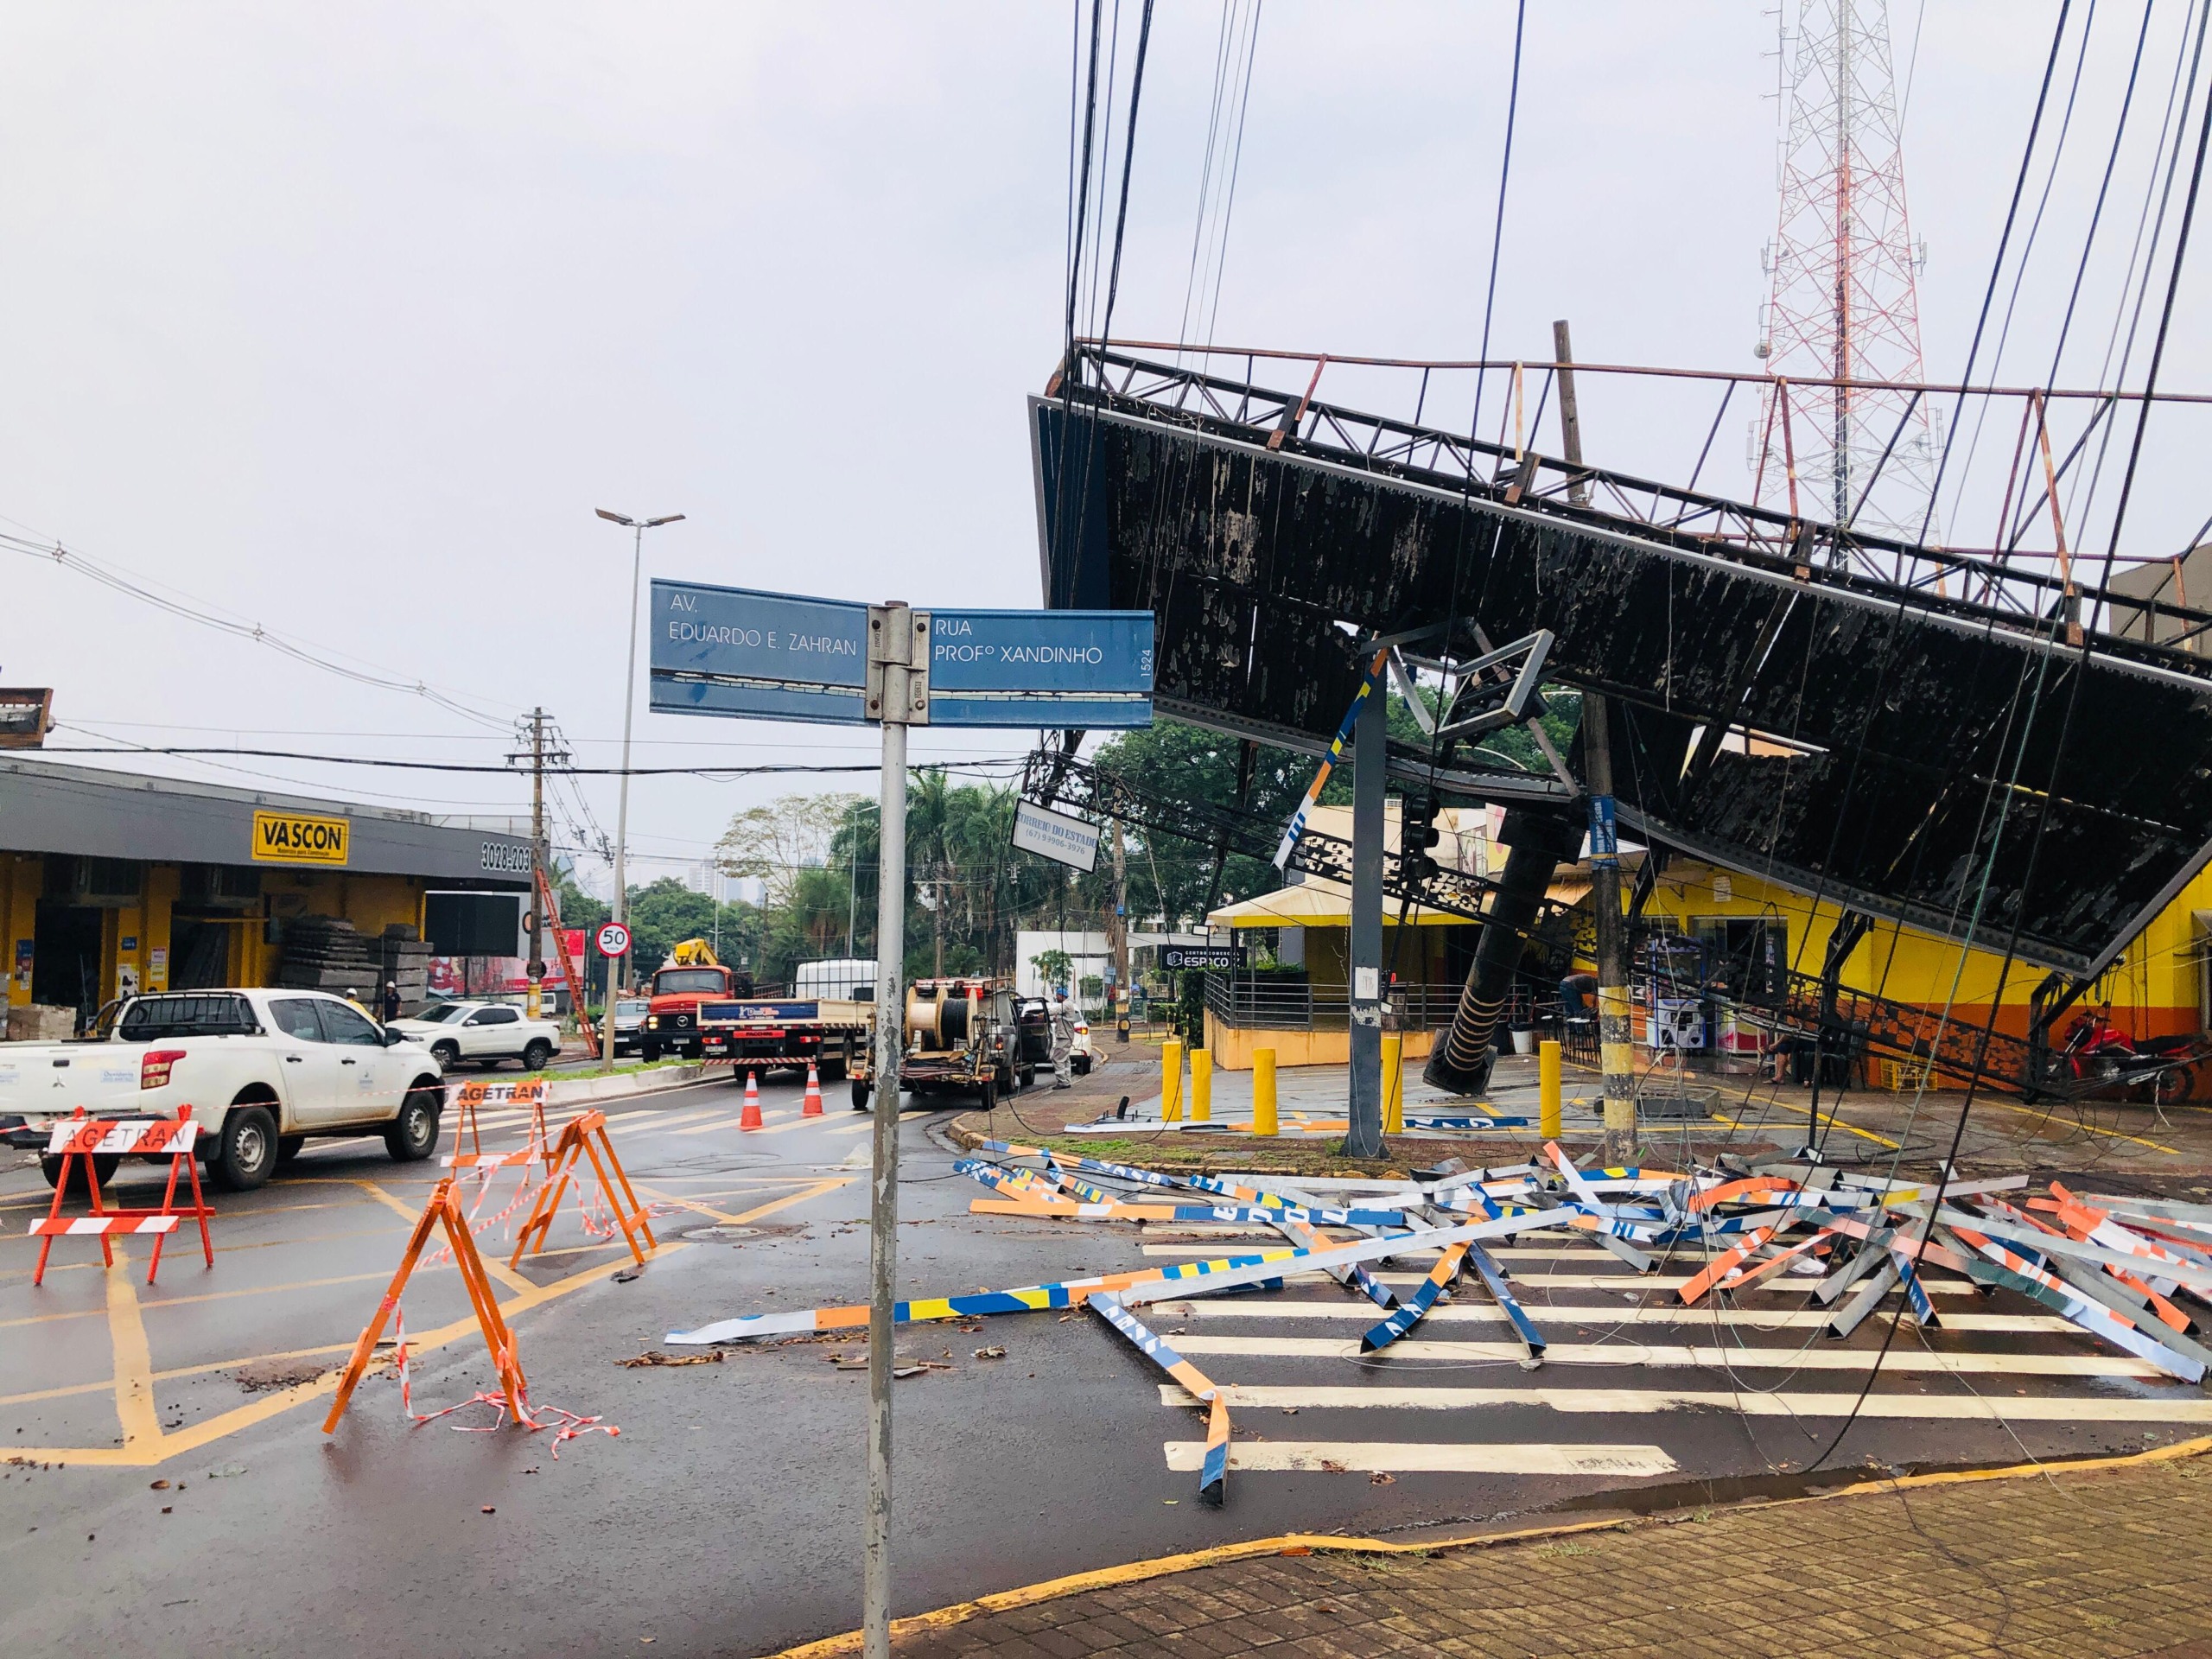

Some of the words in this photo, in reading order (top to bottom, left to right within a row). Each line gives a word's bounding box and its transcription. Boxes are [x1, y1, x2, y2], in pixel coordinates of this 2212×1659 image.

[670, 594, 698, 613] AV.
[669, 621, 761, 647] EDUARDO
[767, 631, 780, 649] E.
[788, 632, 856, 656] ZAHRAN
[935, 619, 972, 636] RUA
[1001, 645, 1103, 664] XANDINHO
[1140, 649, 1152, 677] 1524
[264, 821, 341, 850] VASCON
[1026, 828, 1040, 841] (67)
[1042, 834, 1085, 855] 99906-3976
[1052, 824, 1065, 837] DO
[1065, 828, 1098, 849] ESTADO
[481, 842, 532, 874] 3028-203
[602, 930, 625, 944] 50
[457, 1085, 543, 1102] AGETRAN
[63, 1128, 187, 1148] AGETRAN
